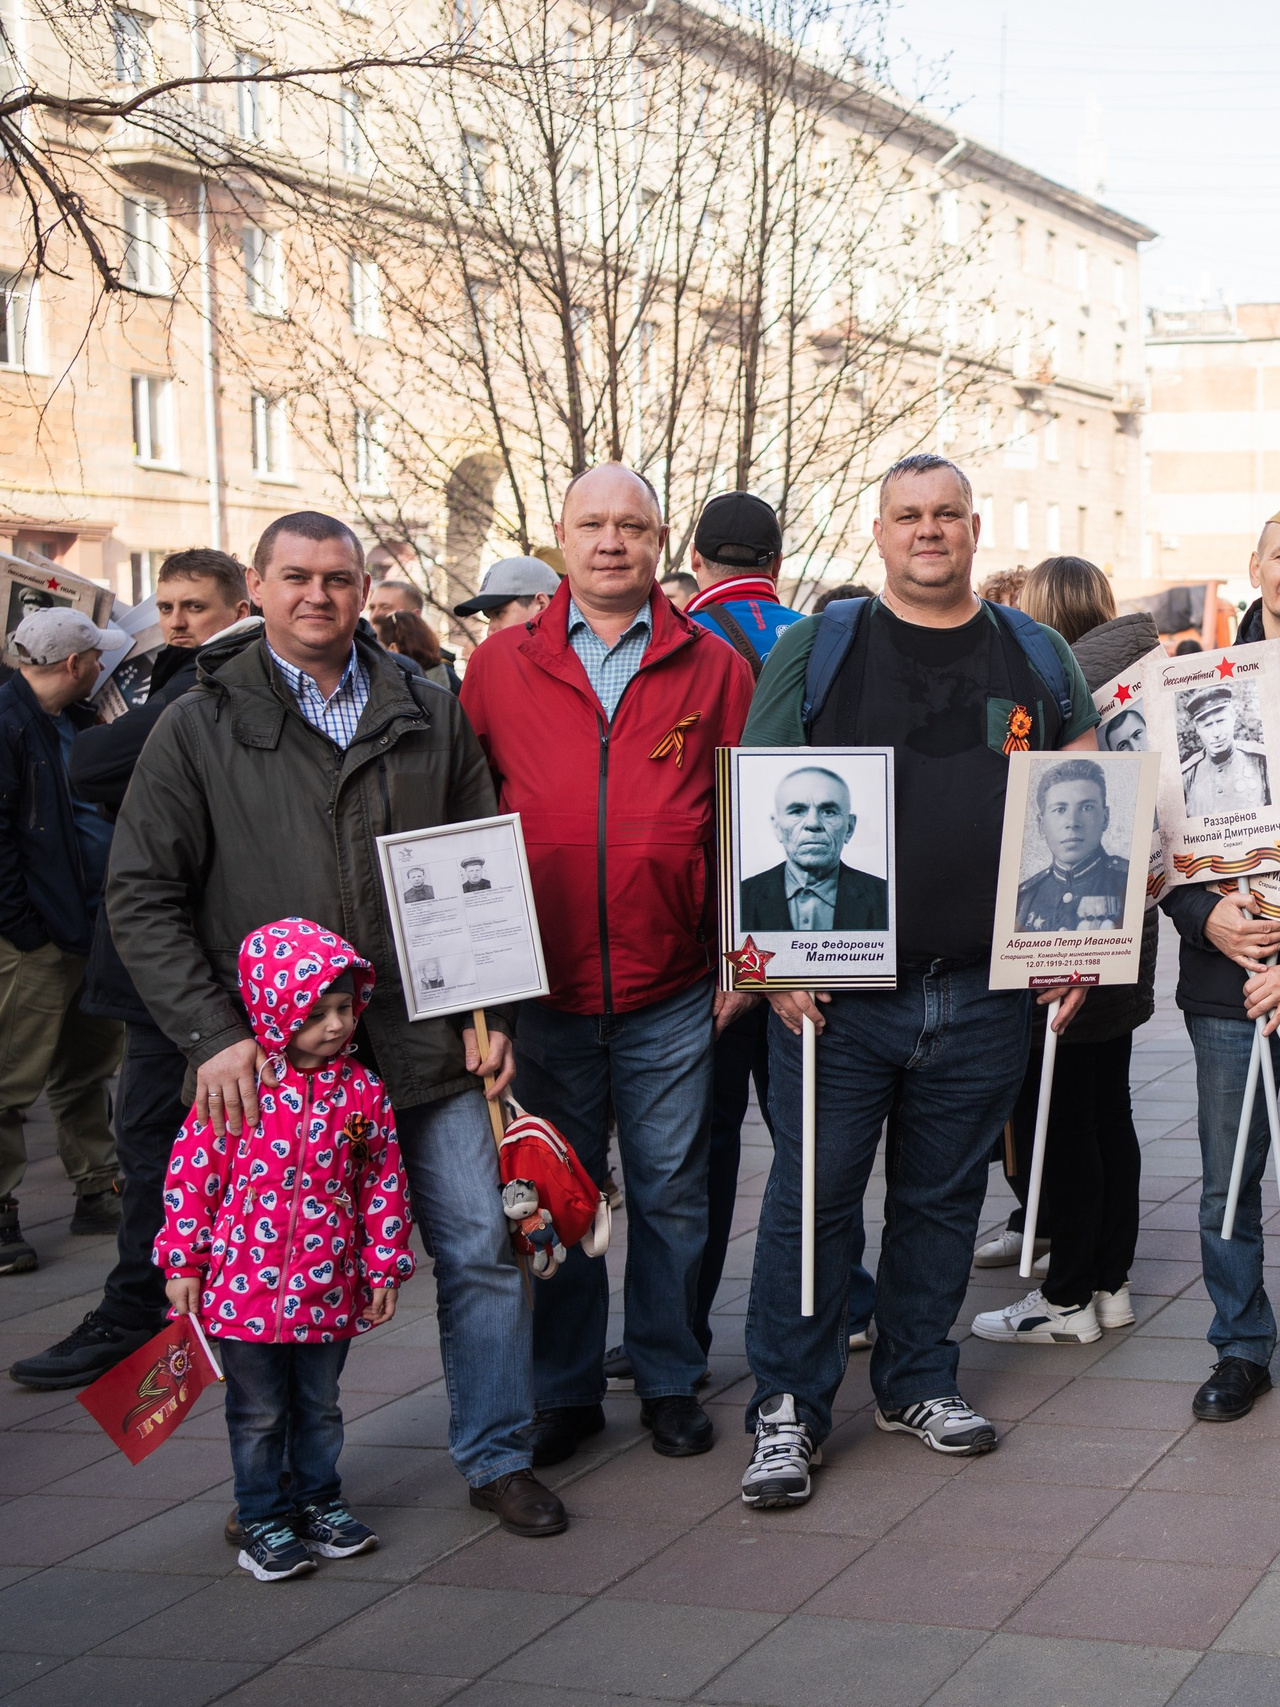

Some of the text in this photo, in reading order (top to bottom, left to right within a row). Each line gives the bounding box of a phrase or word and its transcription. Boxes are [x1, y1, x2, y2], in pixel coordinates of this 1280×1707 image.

[1203, 811, 1257, 828] Раззарёнов
[1183, 829, 1223, 846] Николай
[790, 939, 885, 951] Егор Федорович
[1006, 936, 1133, 951] Абрамов Петр Иванович
[806, 951, 885, 962] Матюшкин
[1037, 952, 1067, 960] Командир
[1025, 958, 1101, 968] 12.07.1919-21.03.1988
